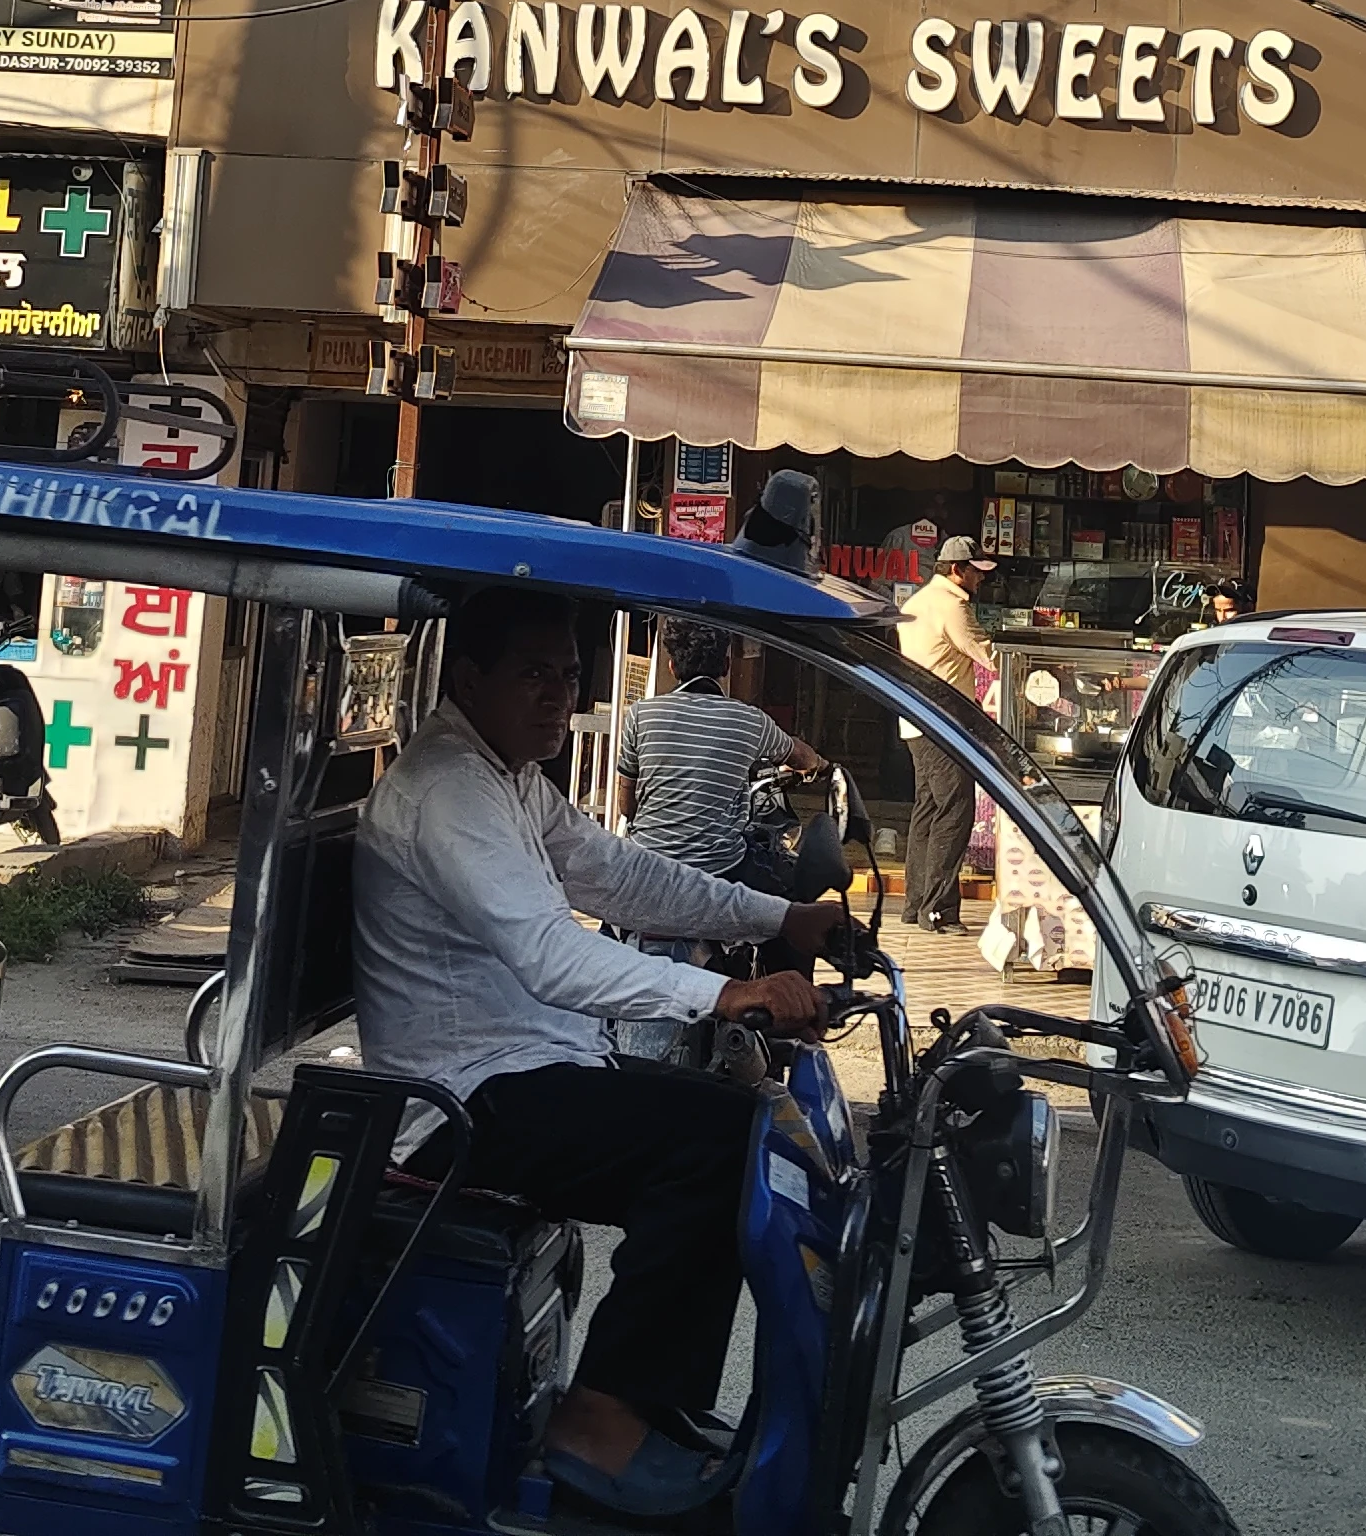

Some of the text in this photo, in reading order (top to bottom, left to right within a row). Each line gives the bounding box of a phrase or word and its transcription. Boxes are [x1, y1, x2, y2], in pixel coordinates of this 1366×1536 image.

[22, 31, 116, 54] SUNDAY)
[905, 17, 1295, 127] SWEETS
[915, 524, 934, 533] PULL
[821, 544, 924, 584] NWAL
[1198, 917, 1301, 950] LODGY
